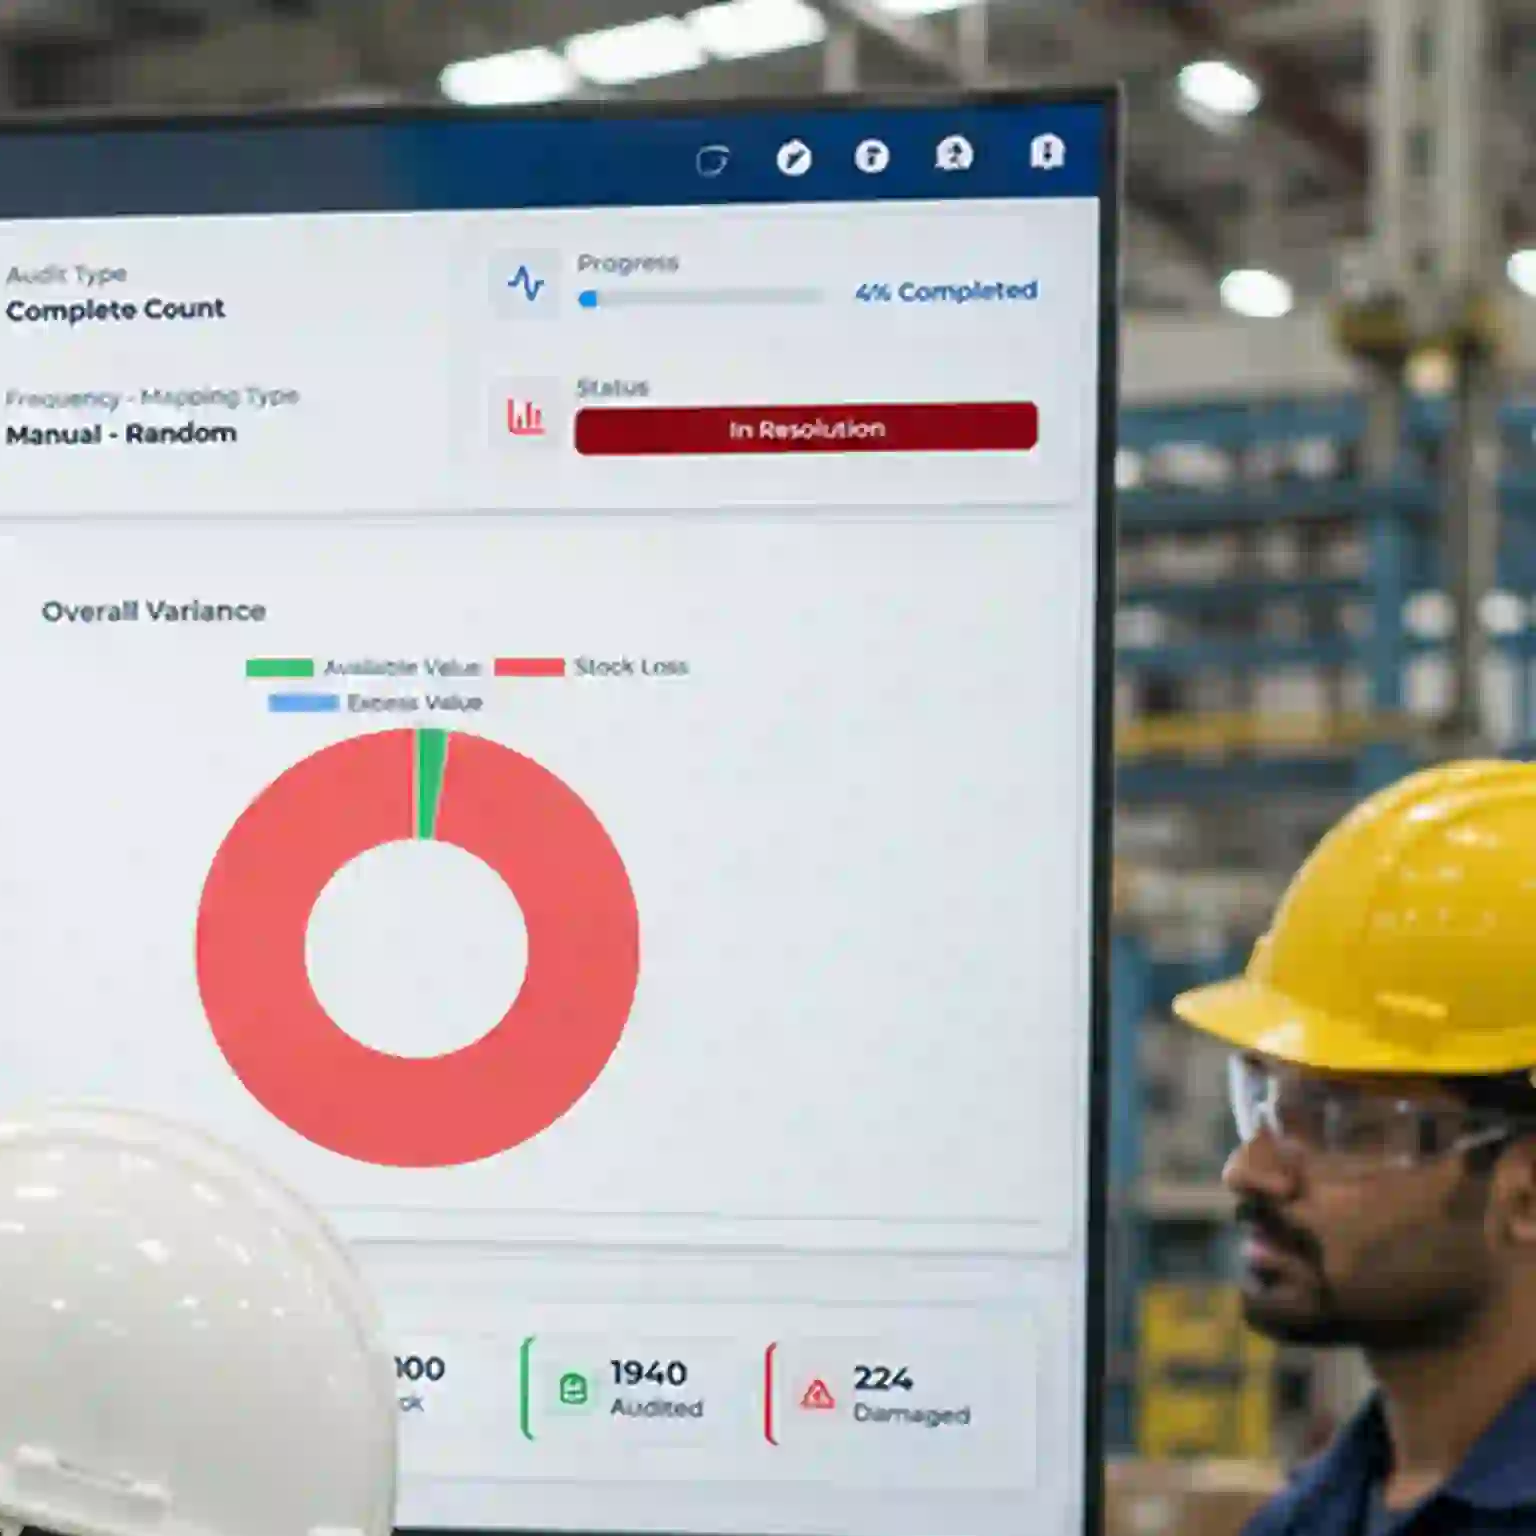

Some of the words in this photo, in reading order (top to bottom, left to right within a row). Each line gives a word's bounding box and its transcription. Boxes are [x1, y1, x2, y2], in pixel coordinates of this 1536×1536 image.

[578, 254, 681, 277] Progress
[856, 284, 893, 303] 4%
[898, 281, 1040, 306] Completed
[6, 299, 139, 327] Complete
[144, 299, 227, 321] Count
[577, 378, 651, 400] Status
[7, 425, 103, 447] Manual
[126, 421, 239, 445] Random
[730, 422, 755, 440] In
[760, 419, 887, 440] Resolution
[42, 601, 140, 625] Overall
[146, 600, 268, 624] Variance
[575, 658, 636, 678] Stock
[611, 1360, 689, 1387] 1940
[855, 1366, 915, 1392] 224
[611, 1398, 705, 1420] Audited
[854, 1402, 973, 1430] Damaged
